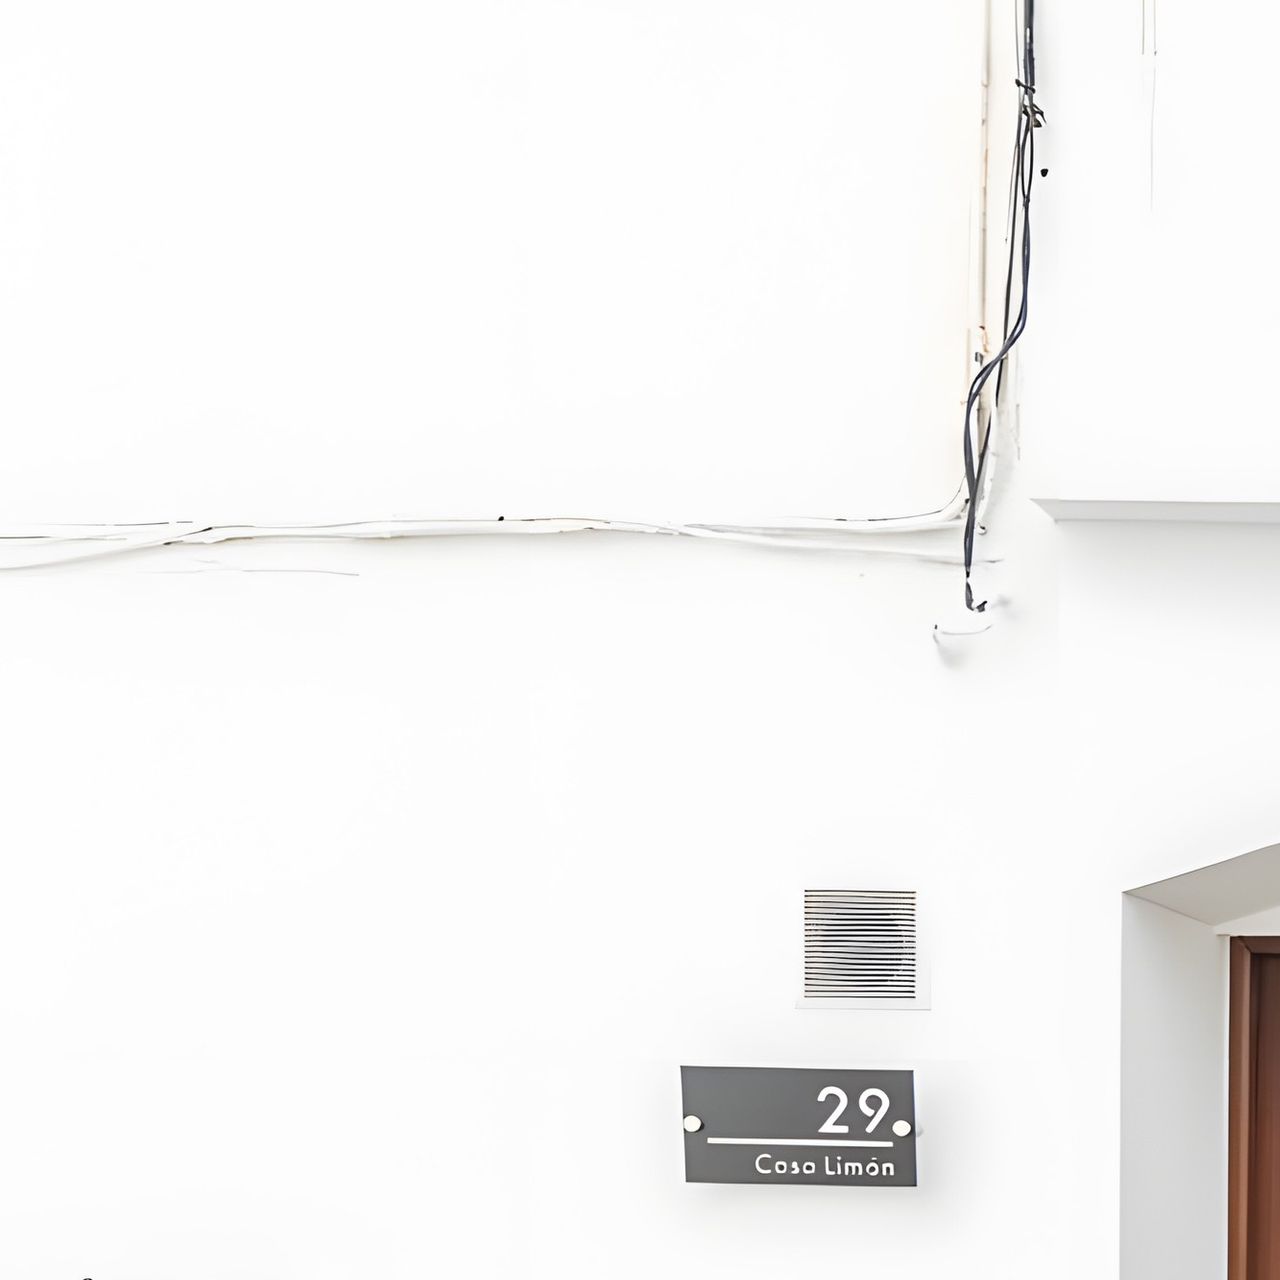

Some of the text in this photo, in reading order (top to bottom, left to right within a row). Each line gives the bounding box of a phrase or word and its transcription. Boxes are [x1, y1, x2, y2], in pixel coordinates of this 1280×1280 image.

[817, 1086, 890, 1134] 29
[754, 1153, 895, 1176] Casa Limón
